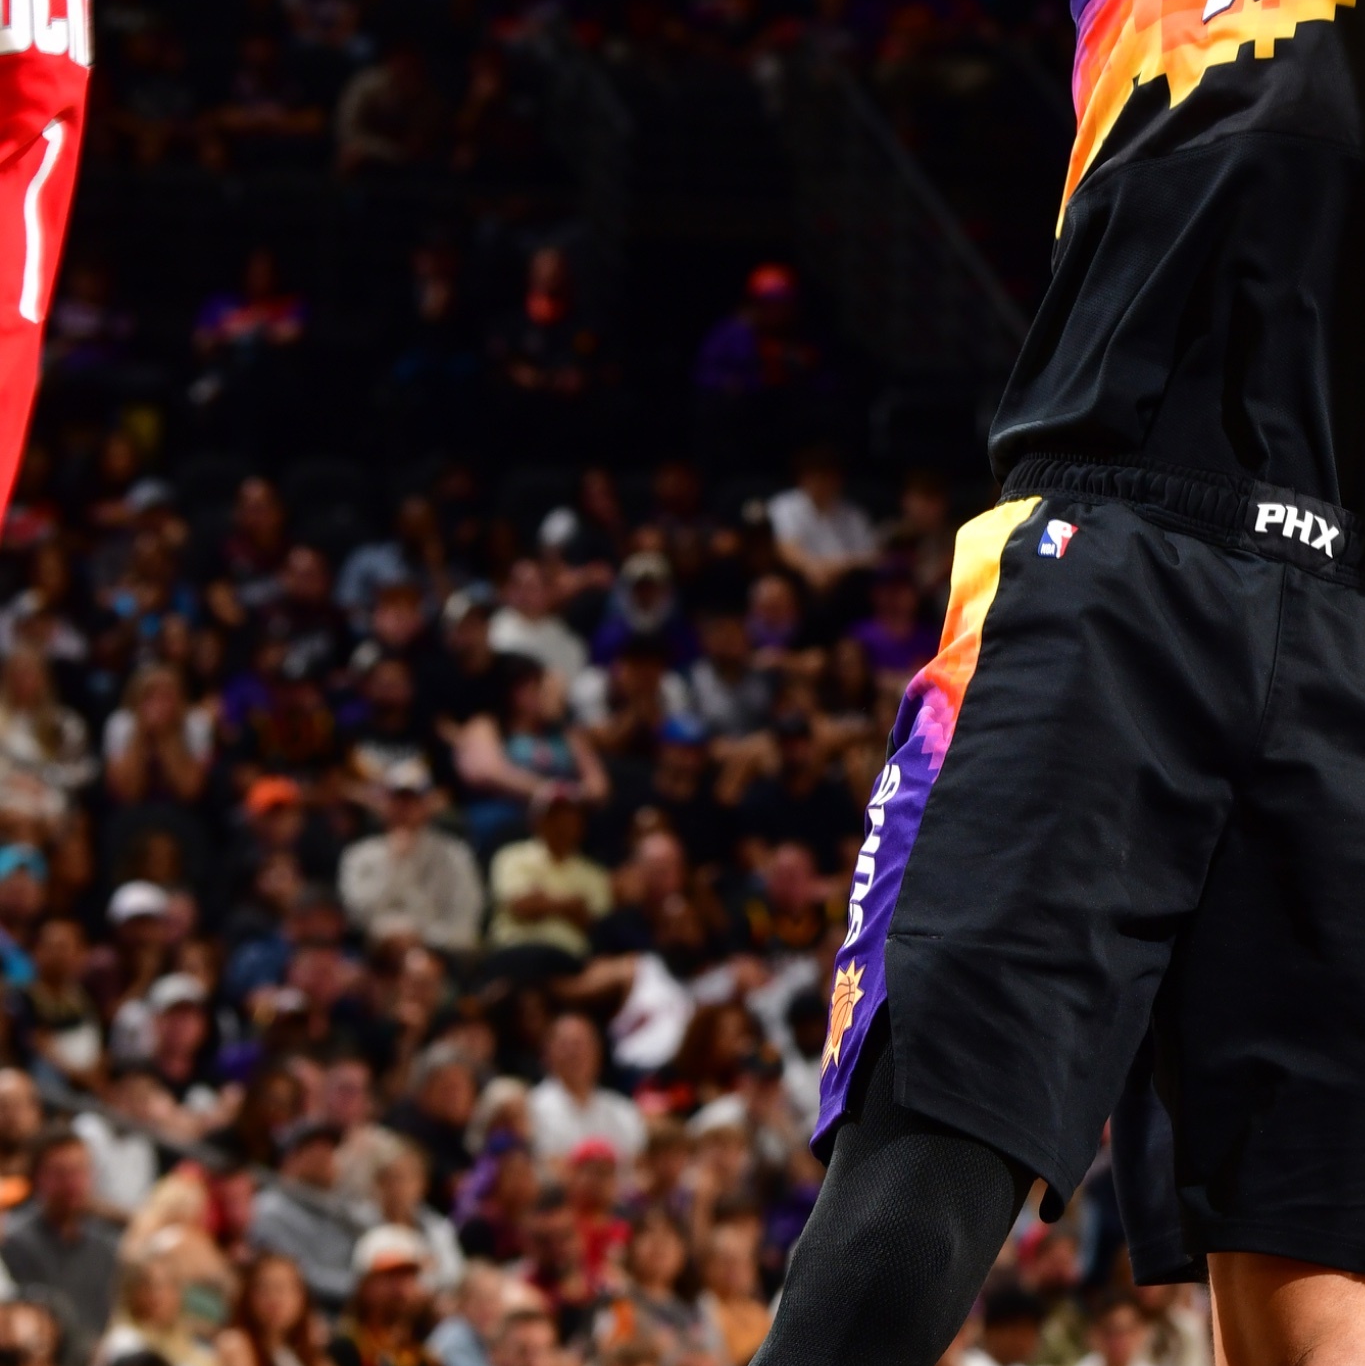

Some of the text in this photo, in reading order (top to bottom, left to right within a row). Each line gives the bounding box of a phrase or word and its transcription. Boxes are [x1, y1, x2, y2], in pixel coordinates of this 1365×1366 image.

[18, 119, 64, 325] 1
[1040, 542, 1055, 556] NBA
[1254, 501, 1340, 559] PHX
